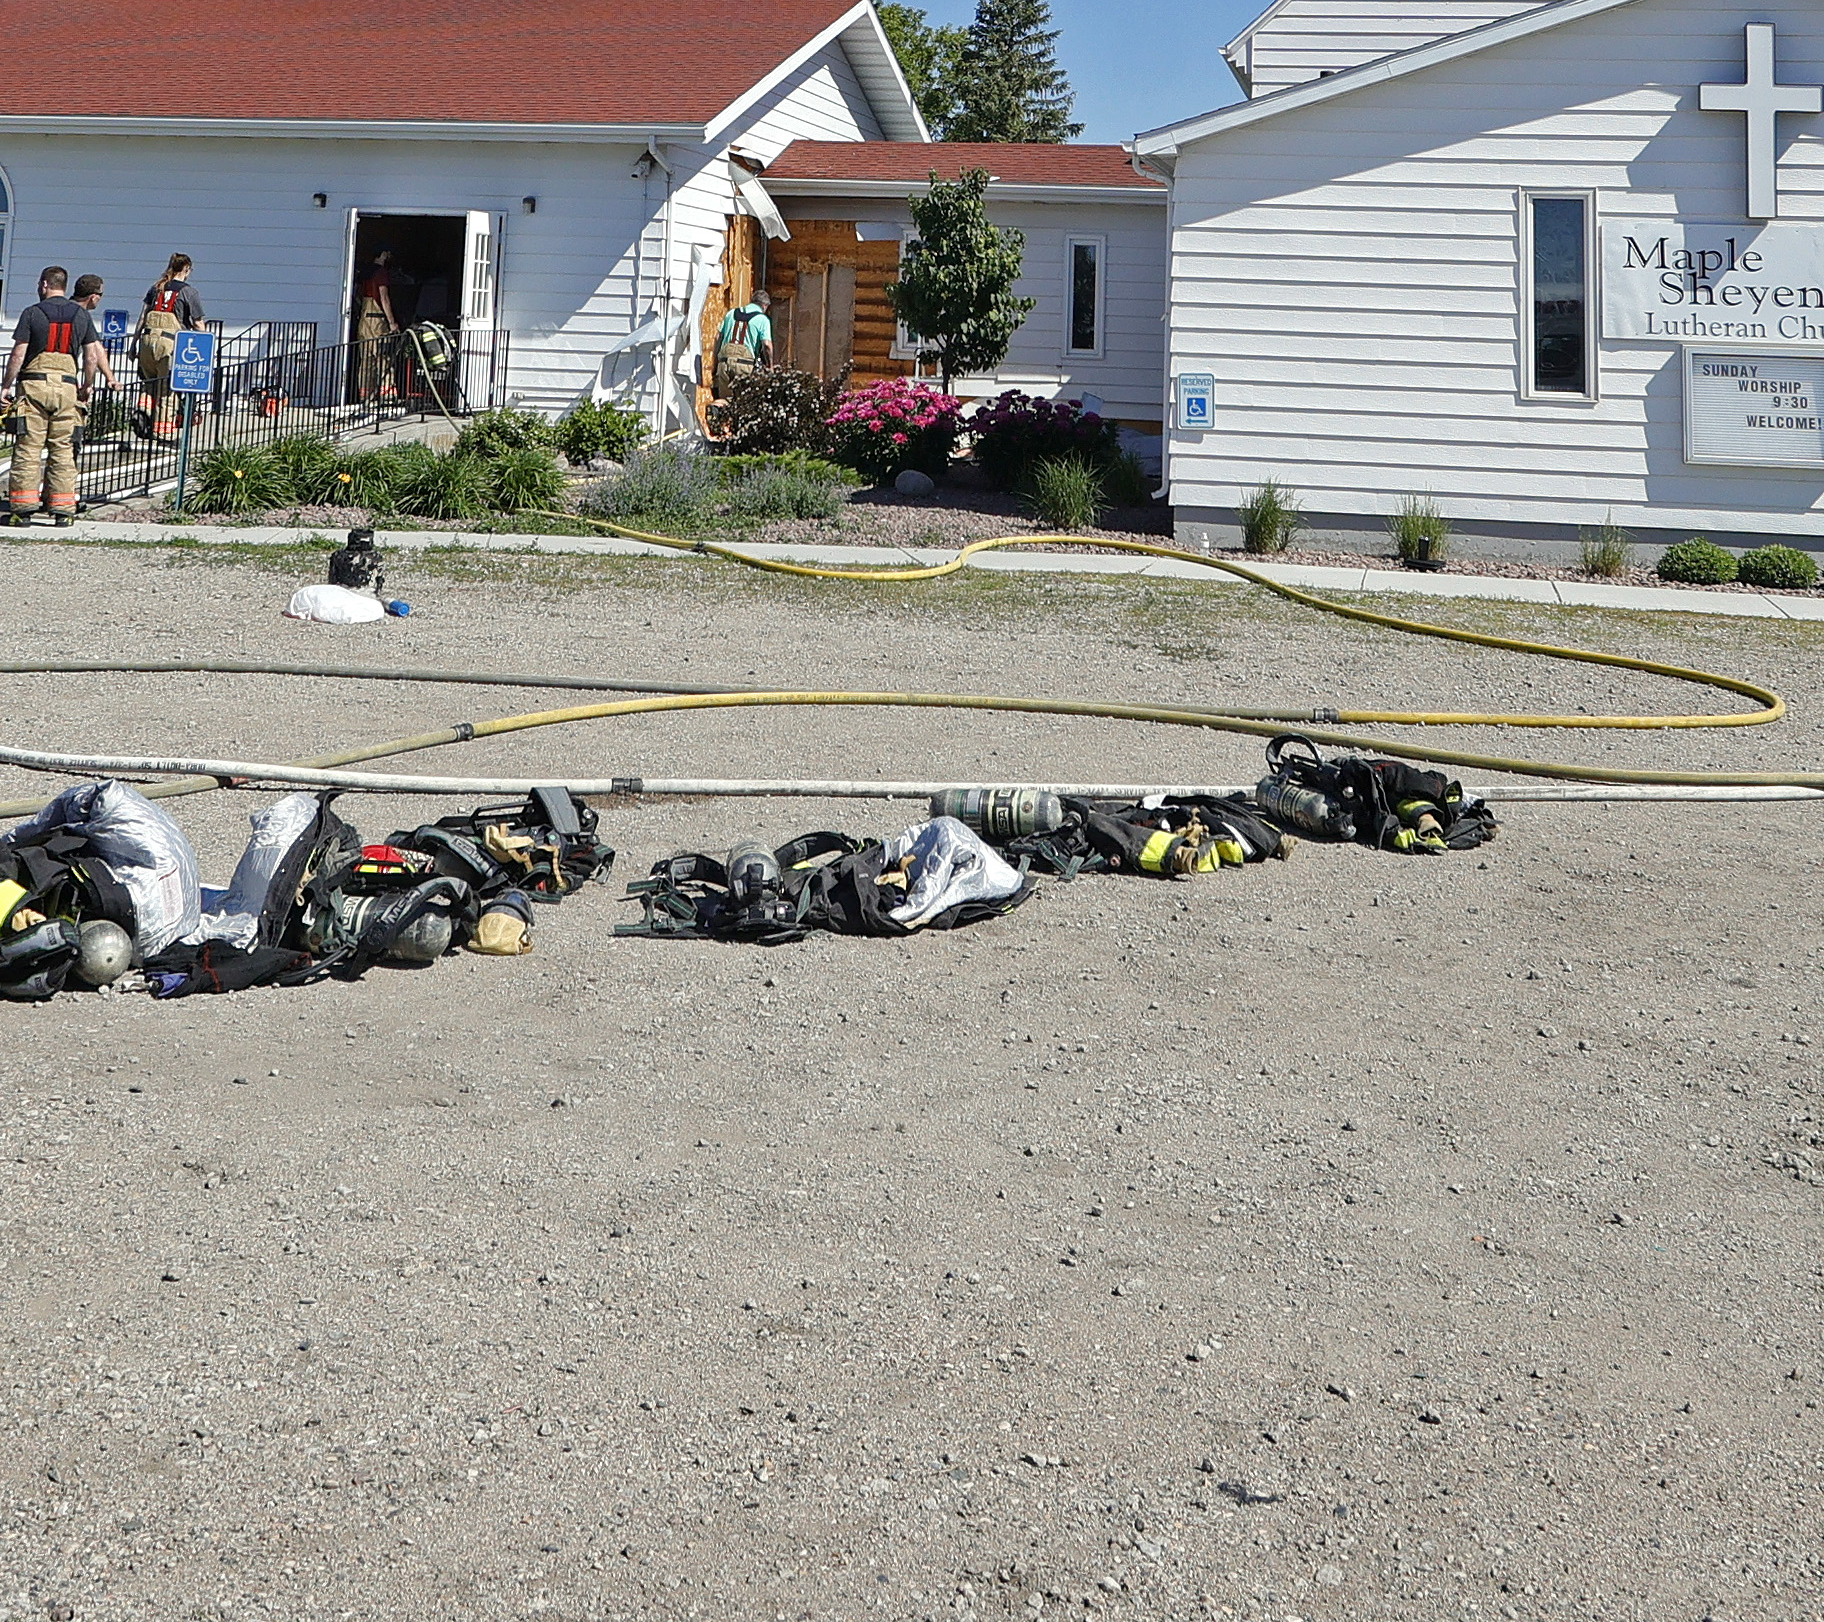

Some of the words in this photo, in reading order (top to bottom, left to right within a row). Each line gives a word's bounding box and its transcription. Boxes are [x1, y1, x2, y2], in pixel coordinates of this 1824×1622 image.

[1622, 235, 1764, 279] Maple
[1644, 311, 1767, 339] Lutheran
[1702, 364, 1758, 378] SUNDAY
[1737, 379, 1802, 394] WORSHIP
[1772, 396, 1808, 409] 9:30
[1746, 415, 1822, 430] WELCOME!
[387, 888, 422, 924] MSA
